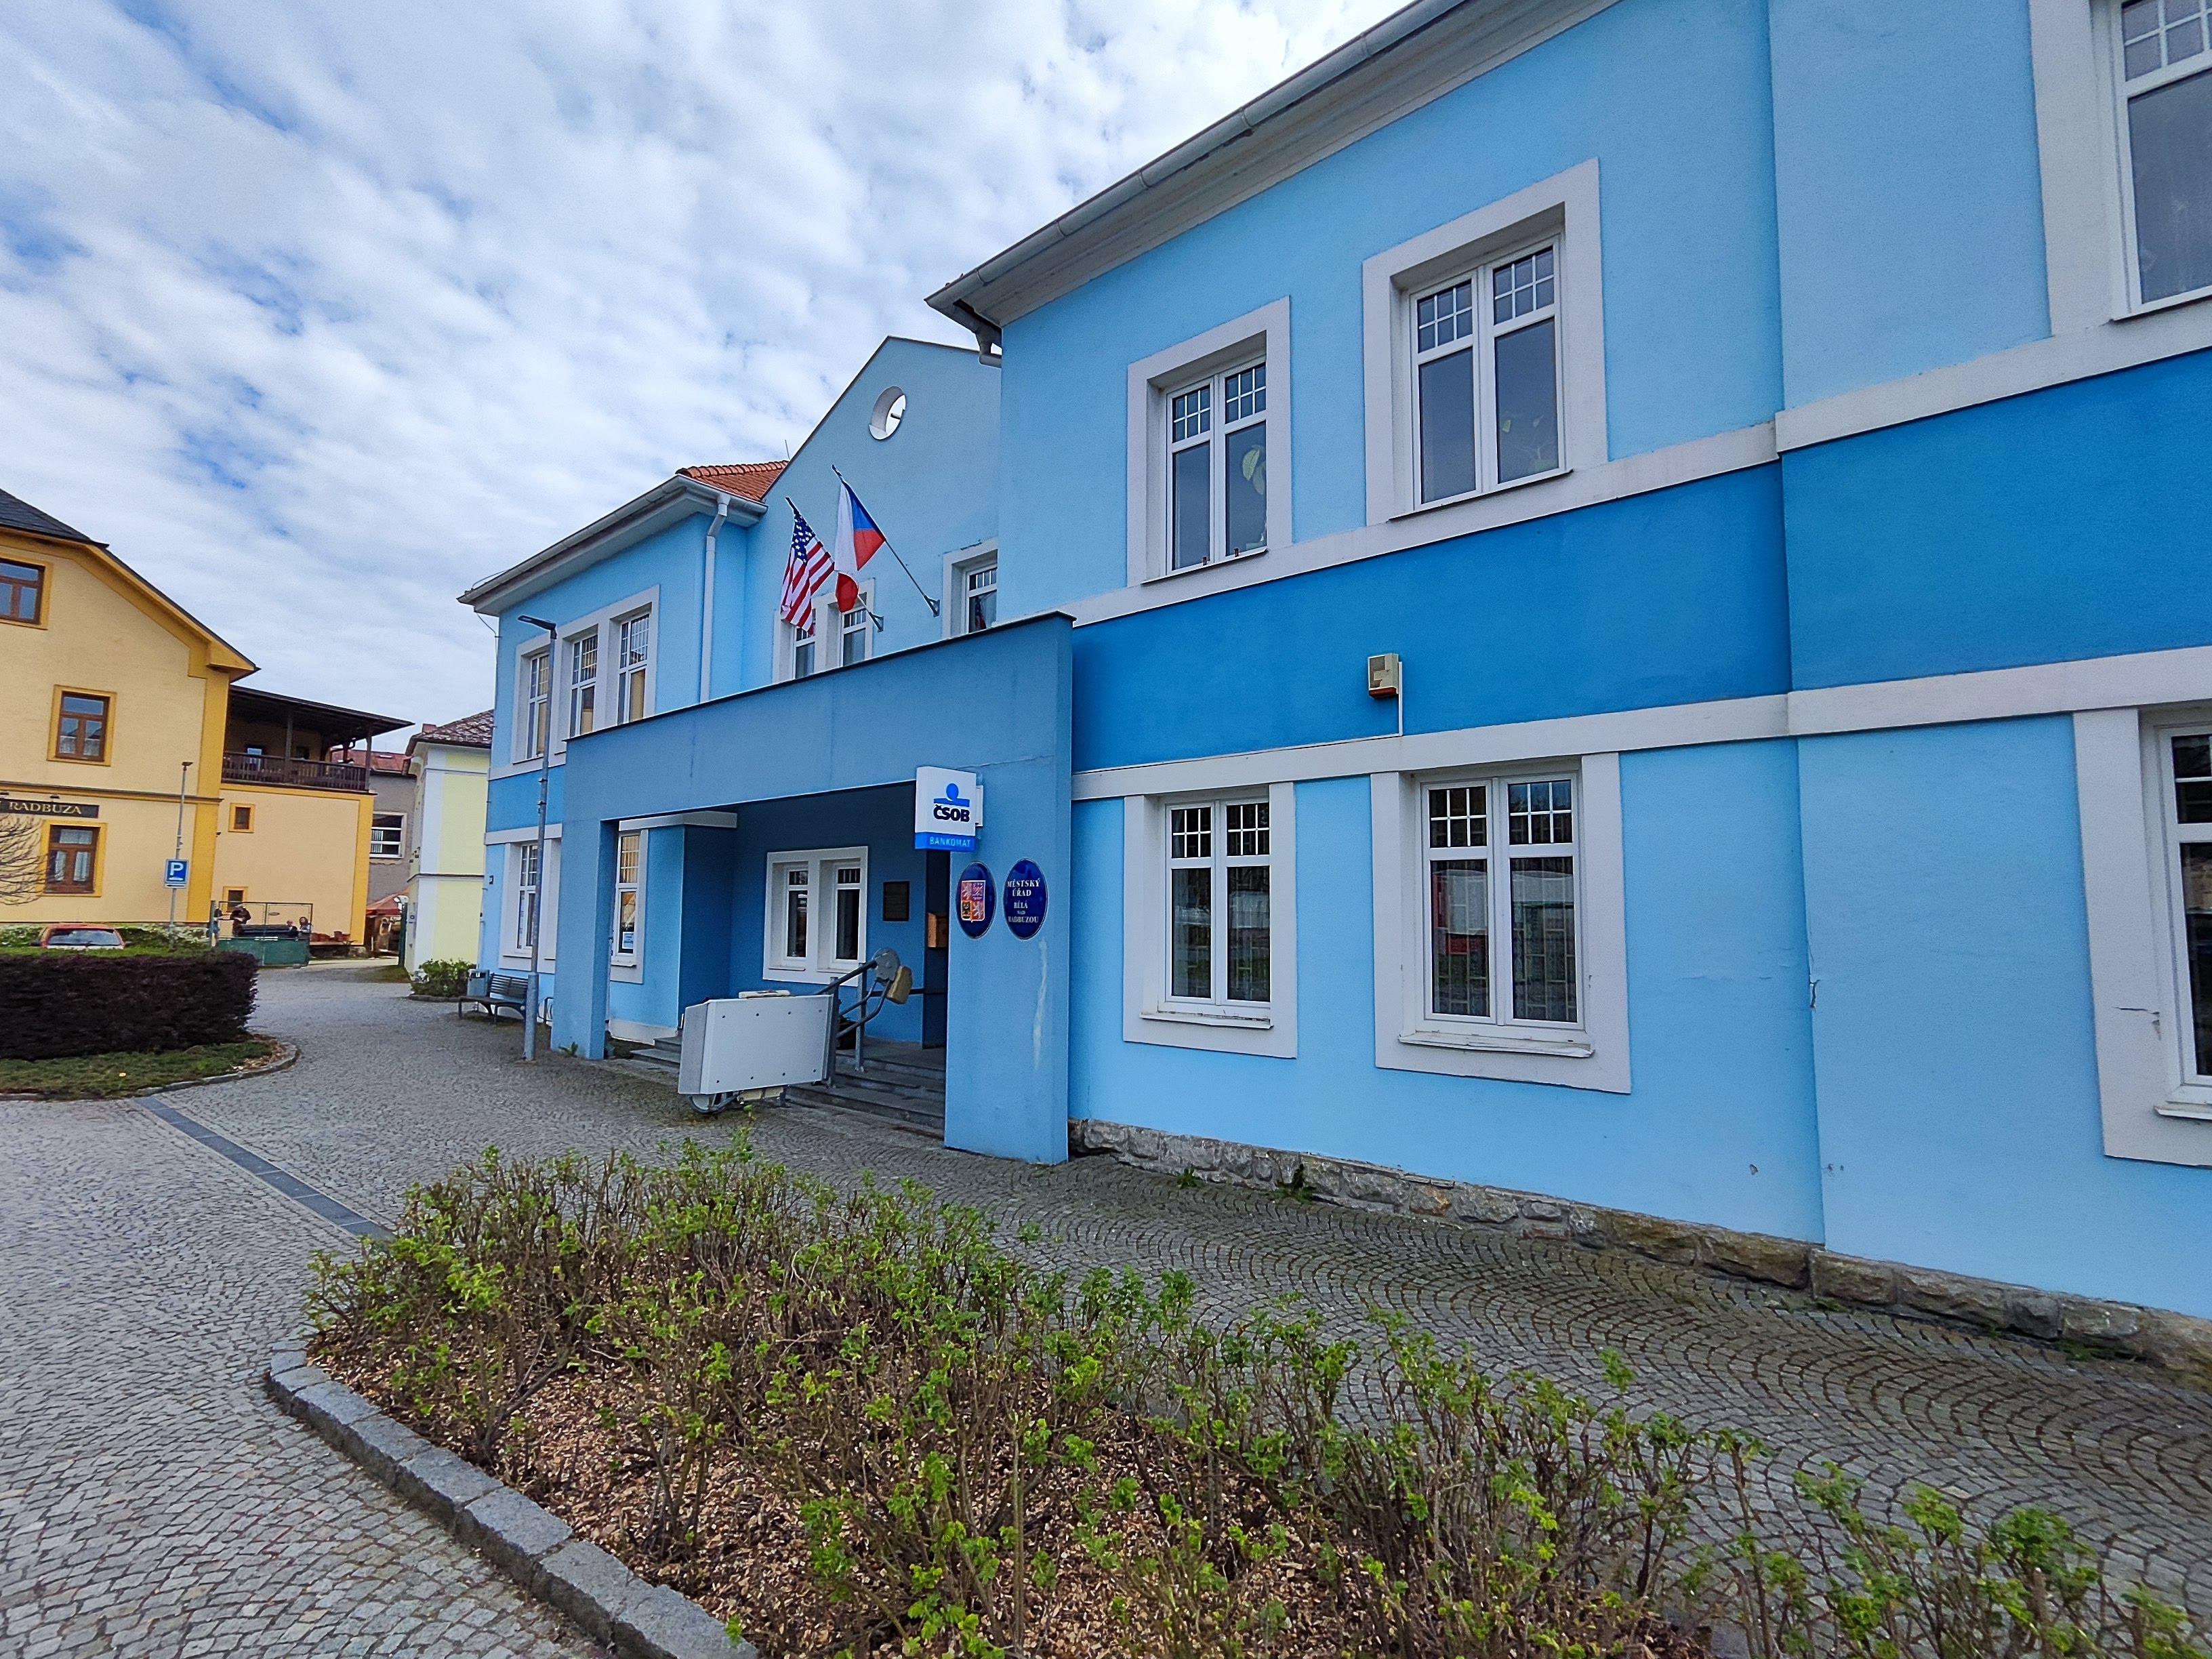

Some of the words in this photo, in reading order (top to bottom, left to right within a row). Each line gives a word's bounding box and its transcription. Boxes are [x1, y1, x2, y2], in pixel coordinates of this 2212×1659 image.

[9, 801, 82, 815] RADBUZA
[933, 804, 970, 823] ČSOB
[929, 836, 970, 848] BANKOMAT
[169, 861, 184, 876] P
[1012, 887, 1031, 897] ÚŘAD
